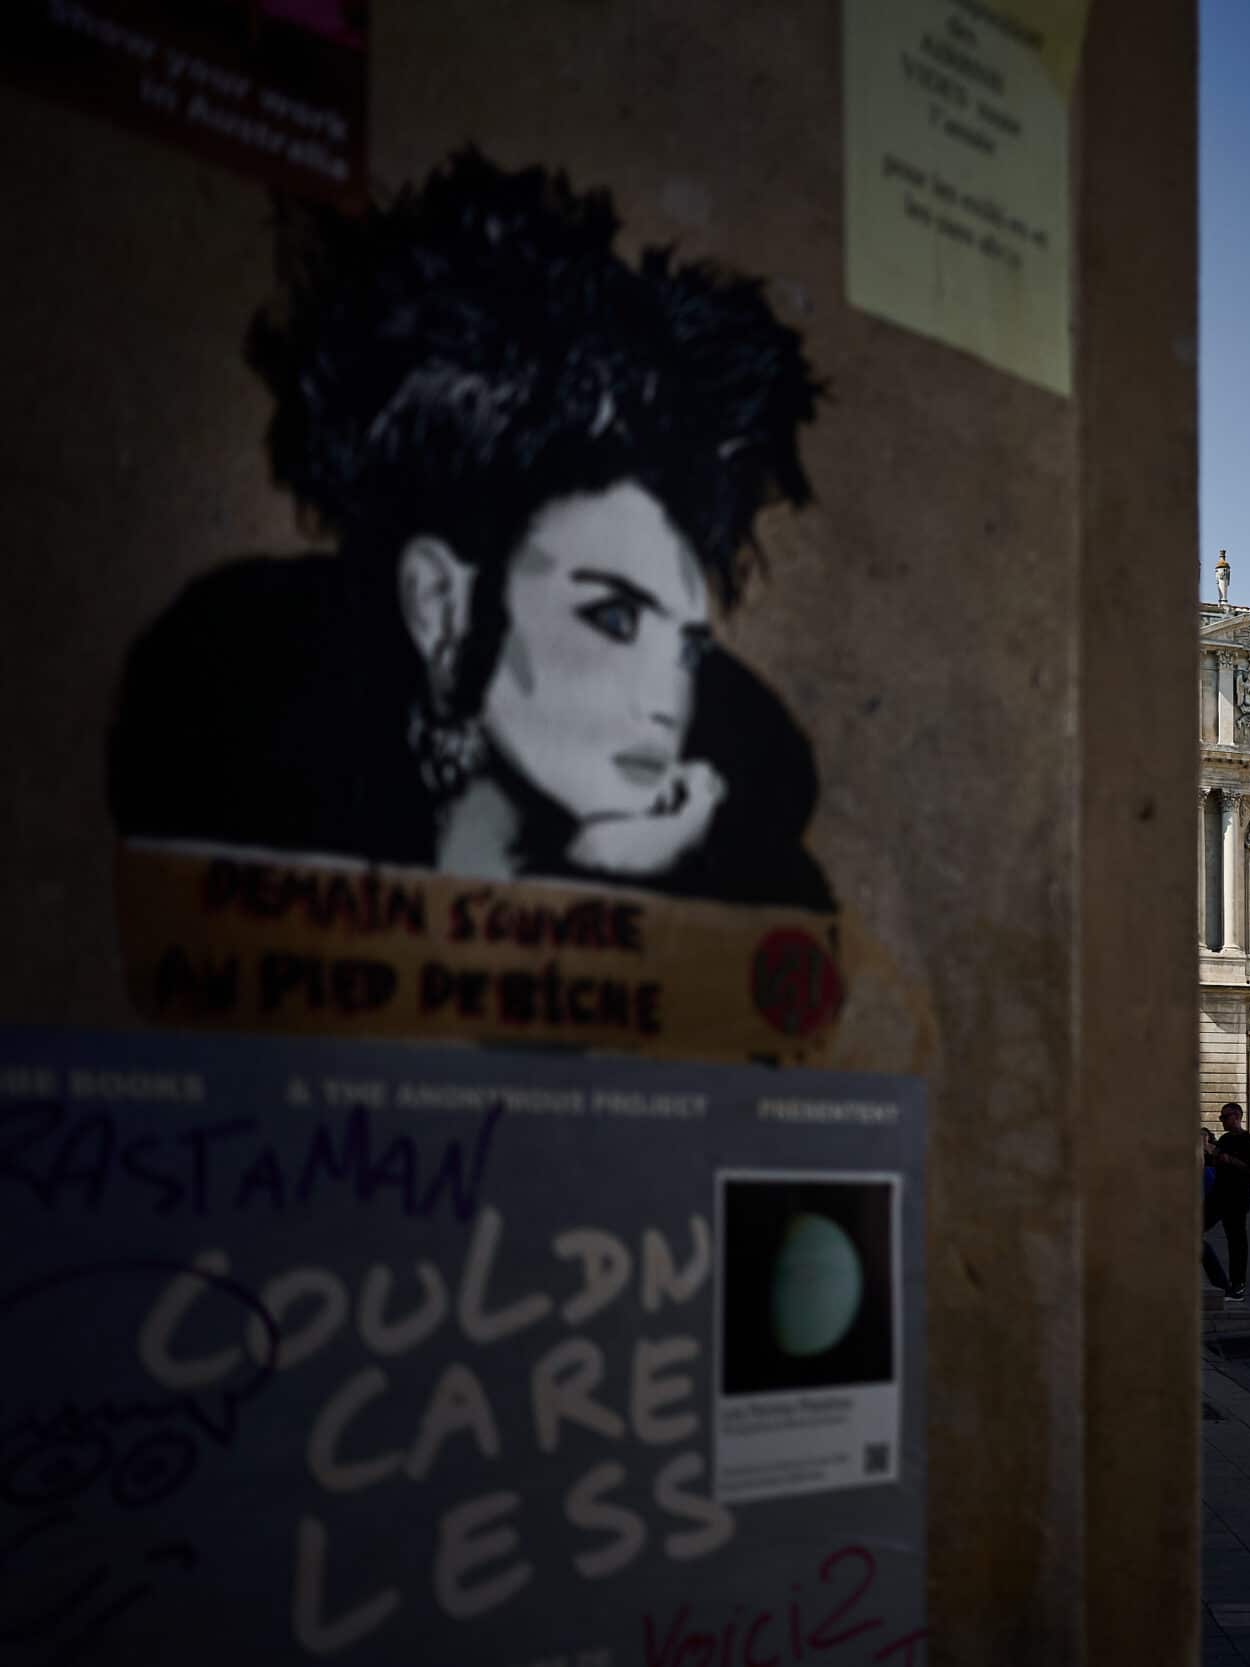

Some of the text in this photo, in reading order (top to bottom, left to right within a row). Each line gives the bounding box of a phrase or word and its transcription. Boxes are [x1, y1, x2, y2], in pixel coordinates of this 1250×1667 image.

[320, 1077, 388, 1109] THE
[592, 1089, 708, 1121] PROJECT
[307, 1334, 702, 1494] CARE
[291, 1450, 737, 1656] LESS
